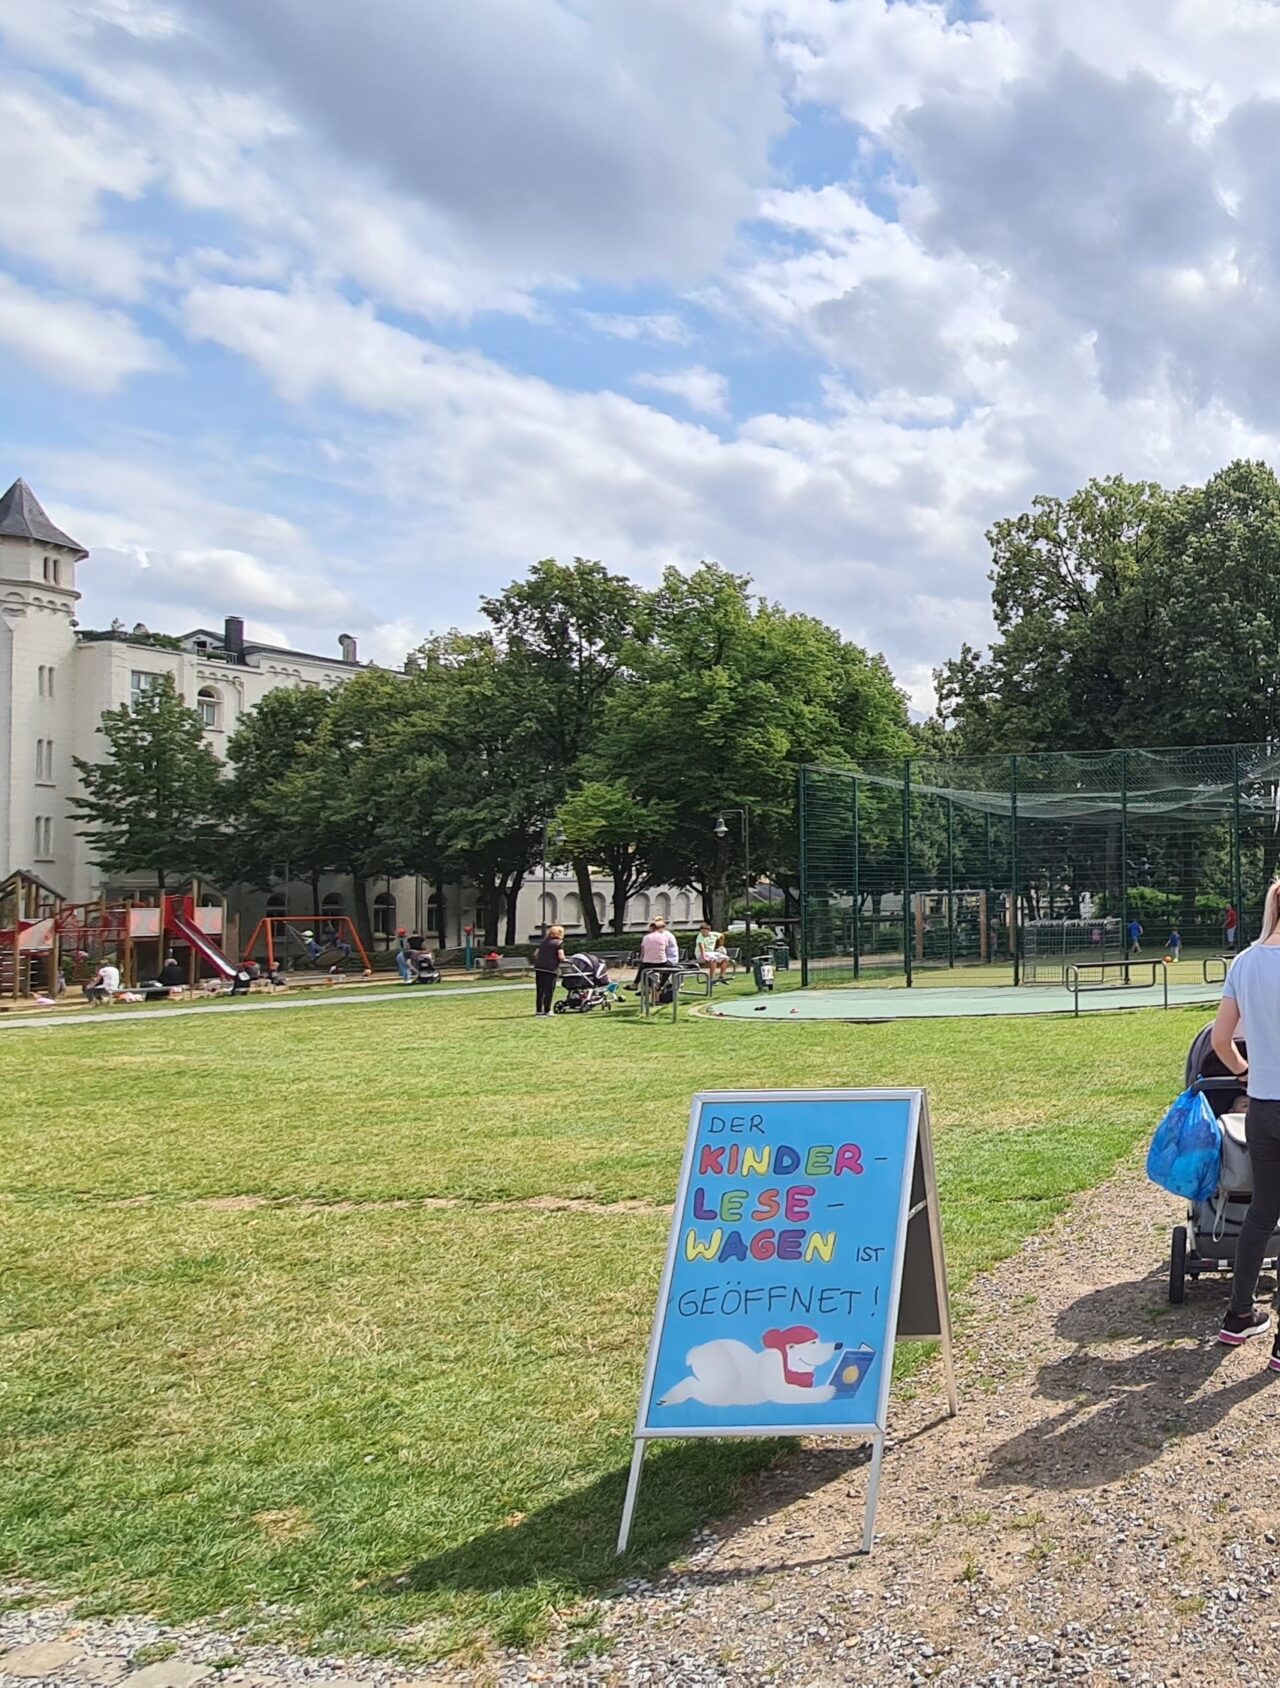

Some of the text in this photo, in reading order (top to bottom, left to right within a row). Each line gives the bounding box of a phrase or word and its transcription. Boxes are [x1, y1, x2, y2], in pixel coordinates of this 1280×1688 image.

[707, 1114, 766, 1135] DER
[684, 1227, 885, 1264] WAGEN IST
